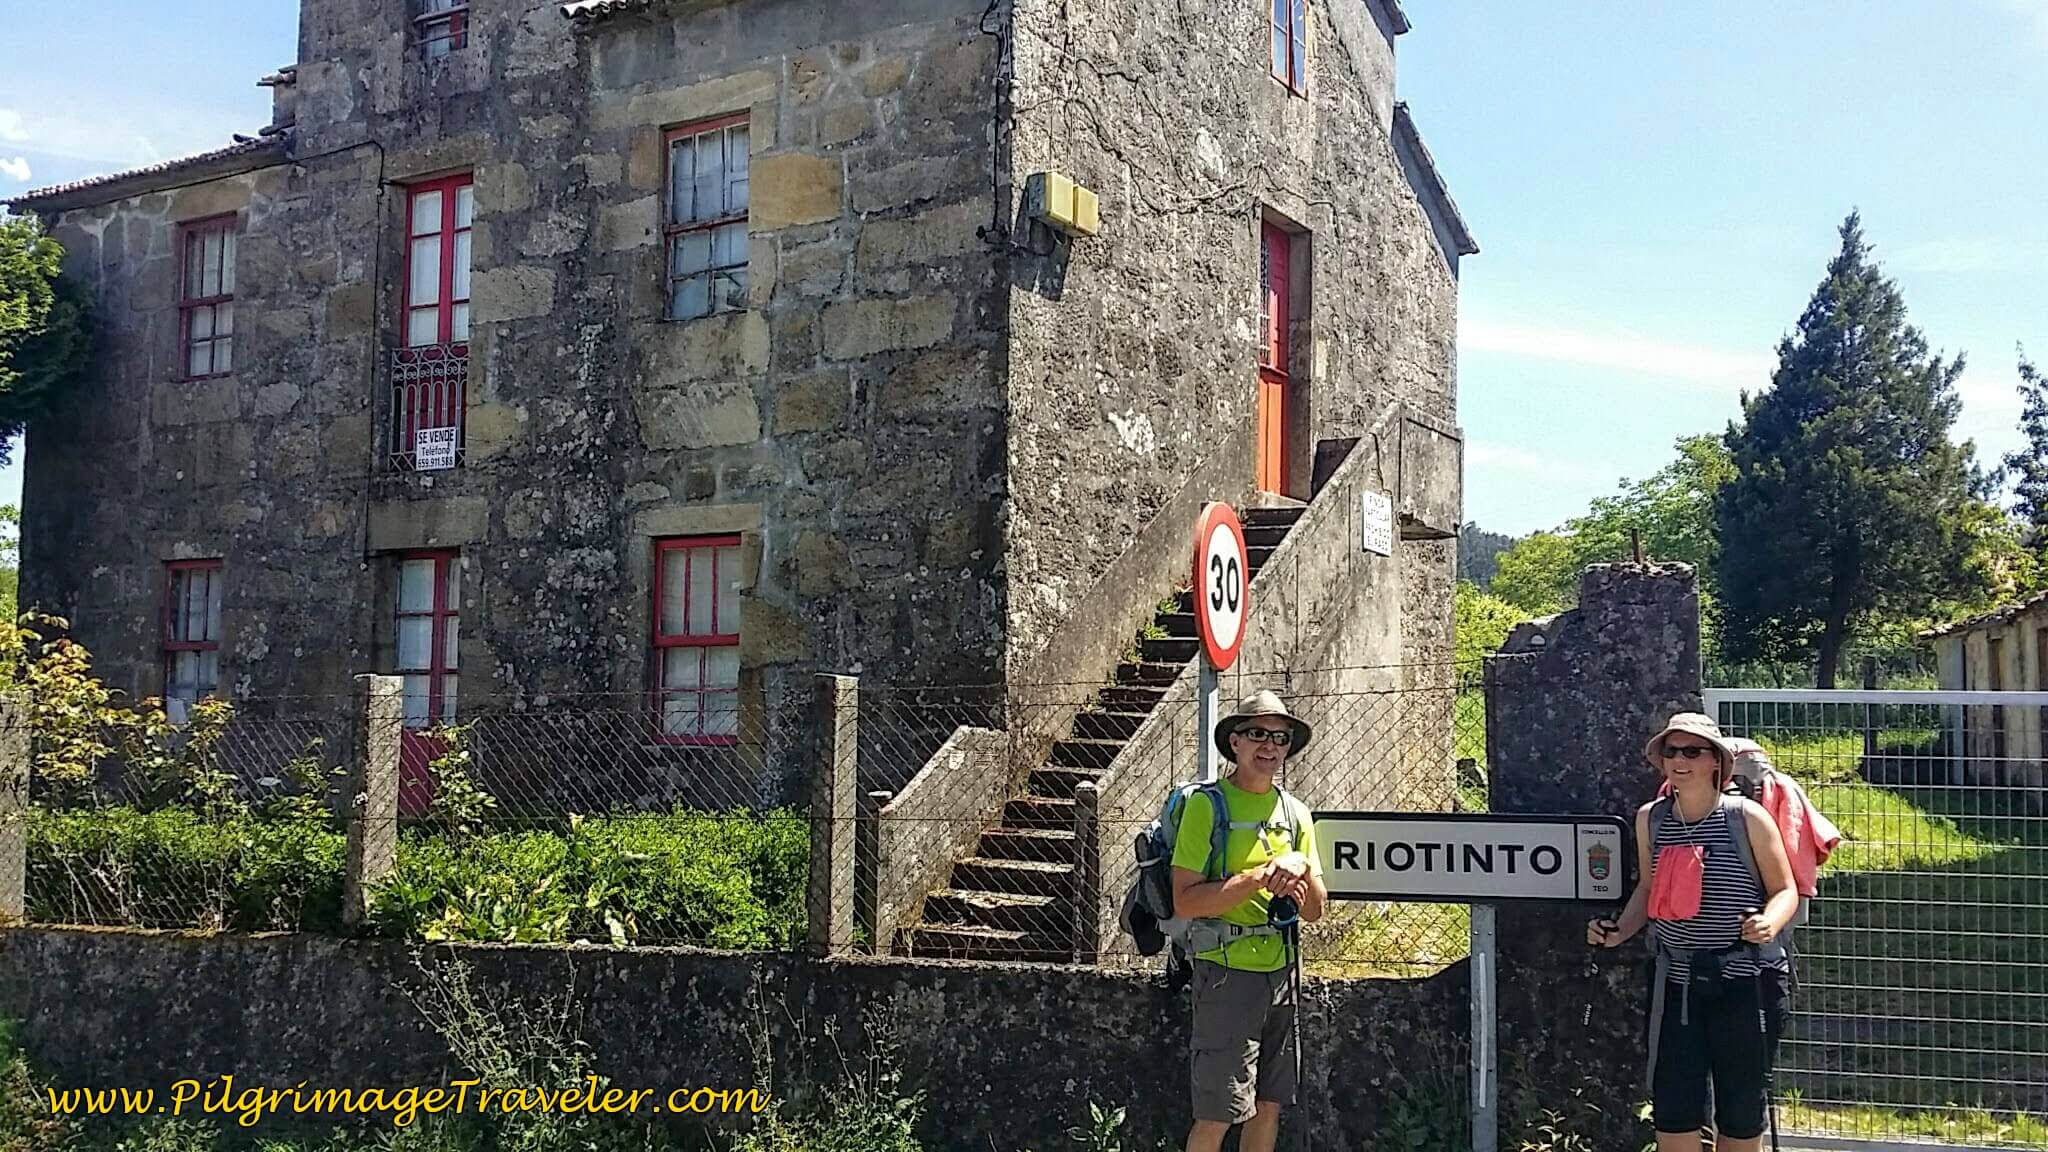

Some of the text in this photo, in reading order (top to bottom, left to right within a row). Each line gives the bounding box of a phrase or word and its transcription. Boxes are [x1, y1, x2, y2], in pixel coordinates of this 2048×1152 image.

[418, 429, 454, 444] SE VENDE
[1211, 554, 1239, 613] 30
[1333, 841, 1563, 875] RIOTINTO
